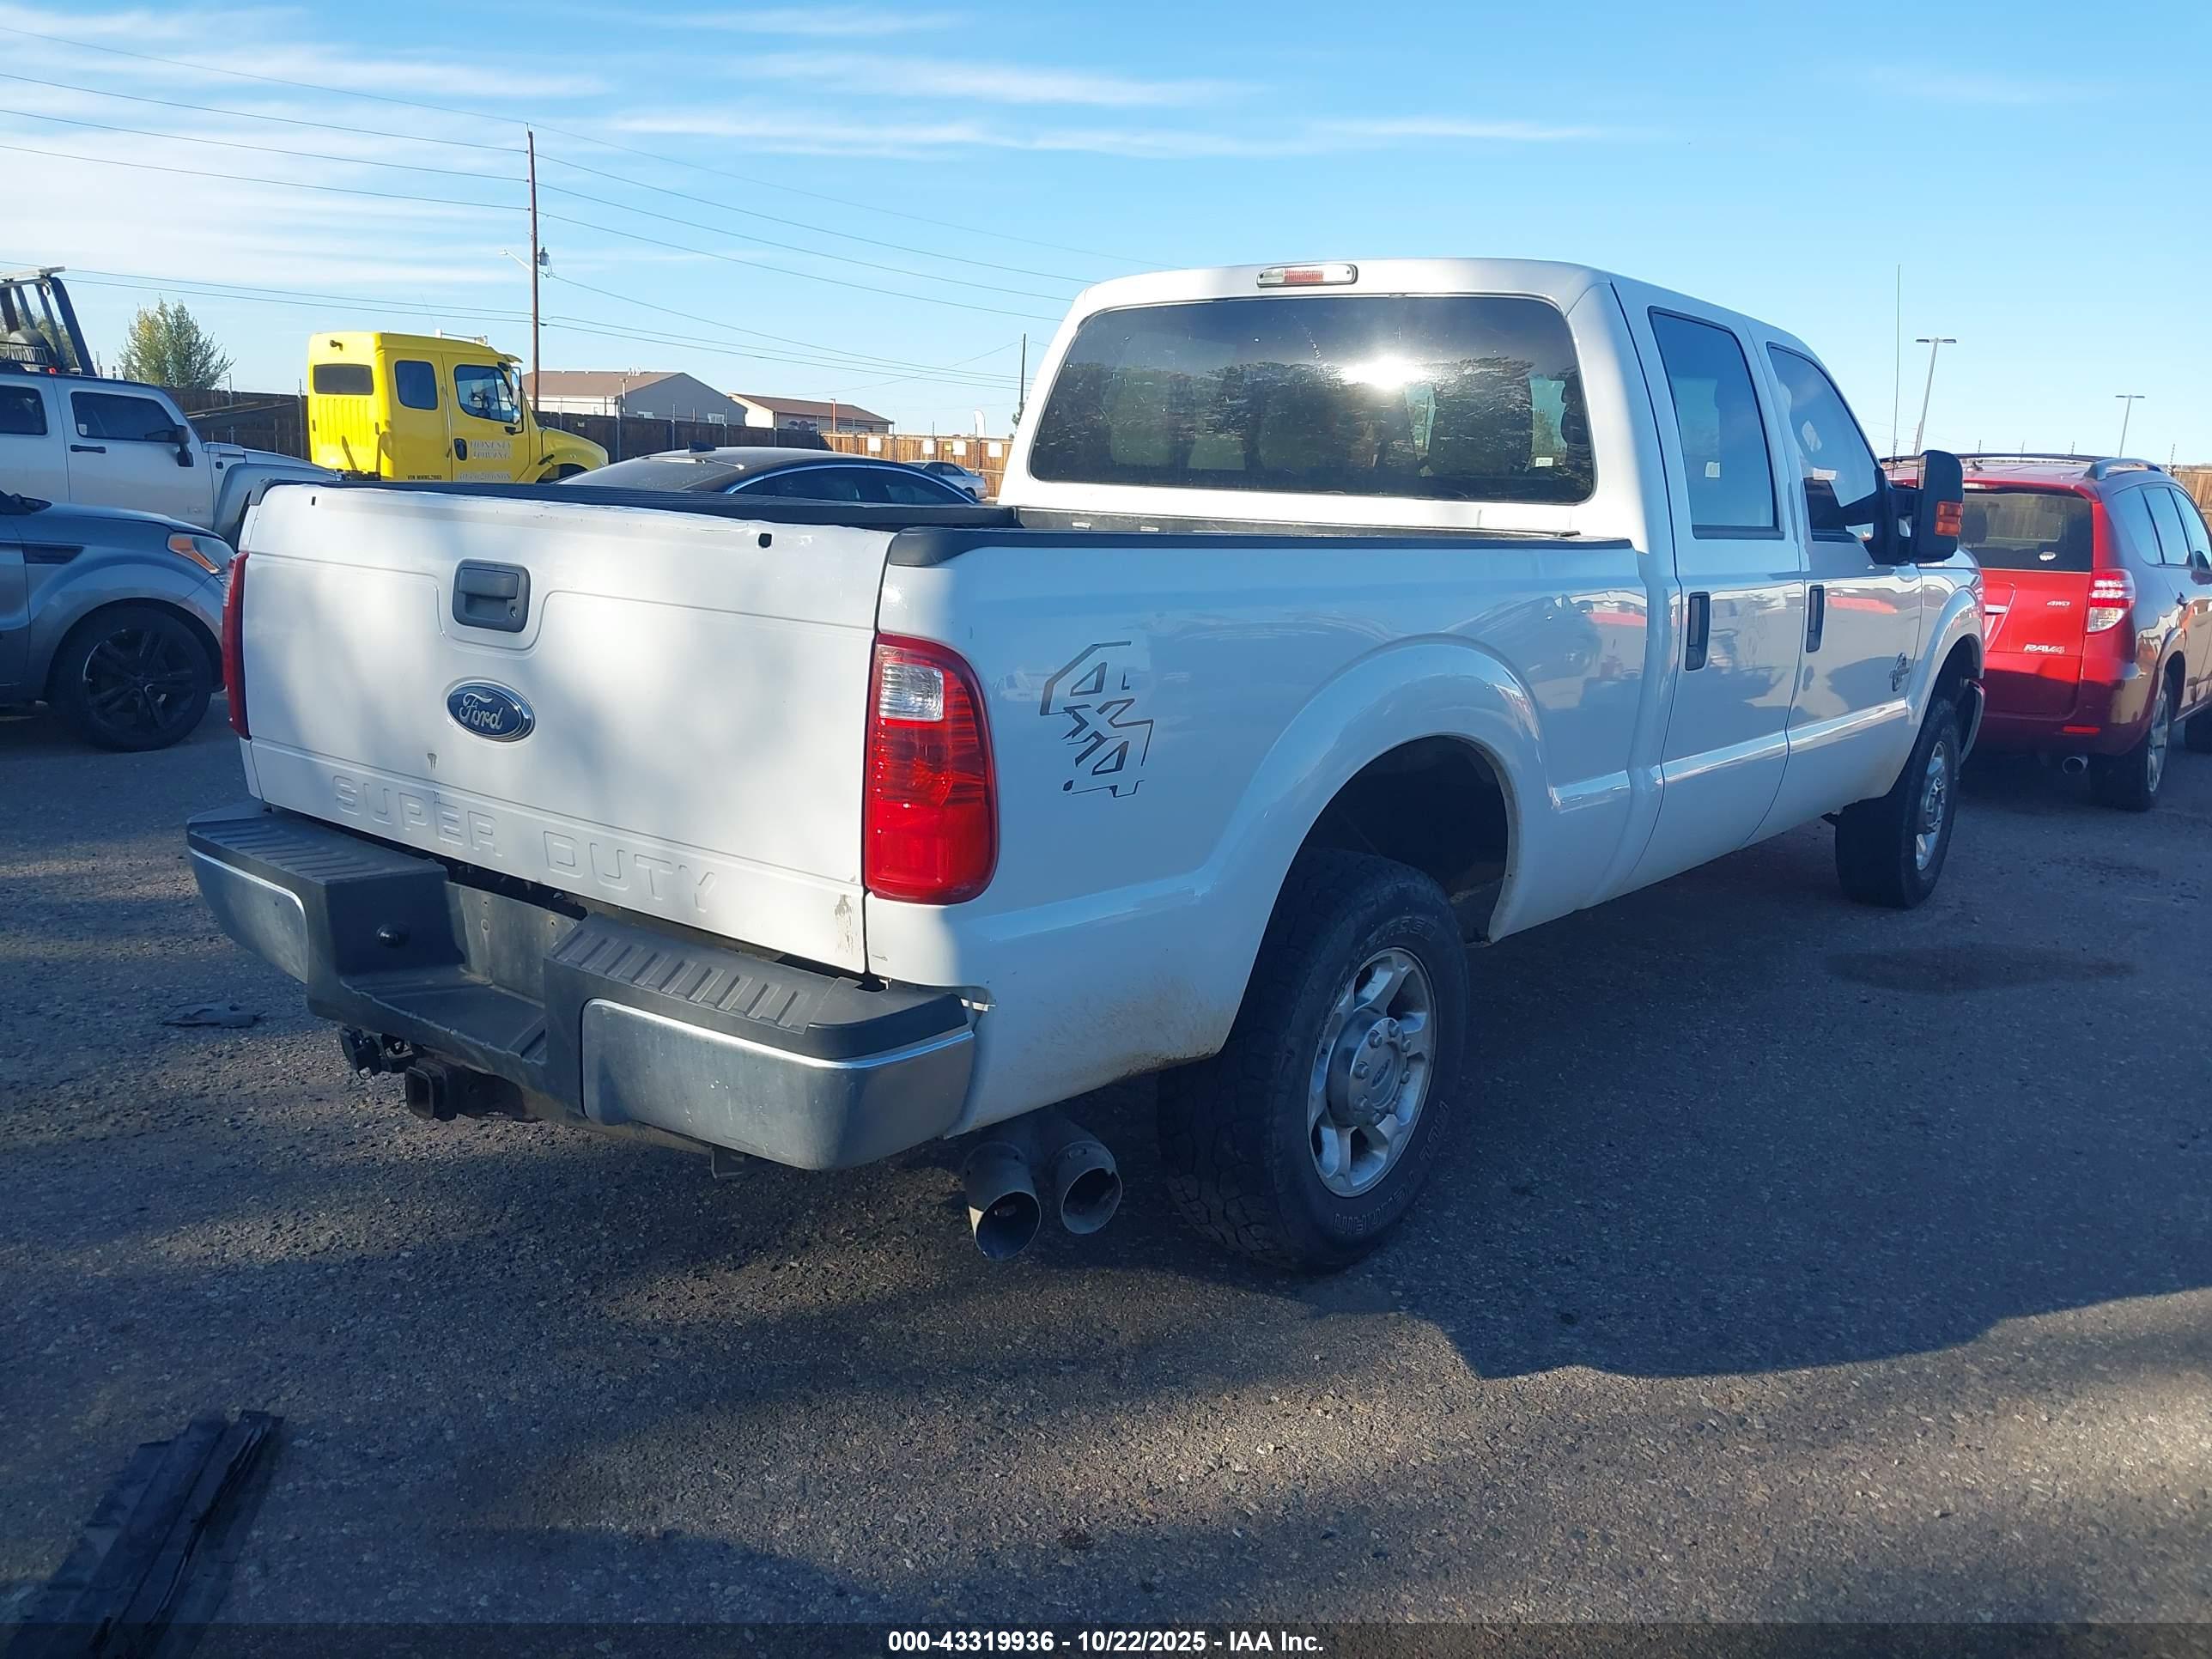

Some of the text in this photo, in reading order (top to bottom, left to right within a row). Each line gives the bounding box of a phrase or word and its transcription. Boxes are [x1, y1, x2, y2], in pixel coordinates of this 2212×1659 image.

[2023, 643, 2065, 653] RAV4
[459, 692, 505, 730] Ford
[332, 775, 716, 913] SUPER DUTY
